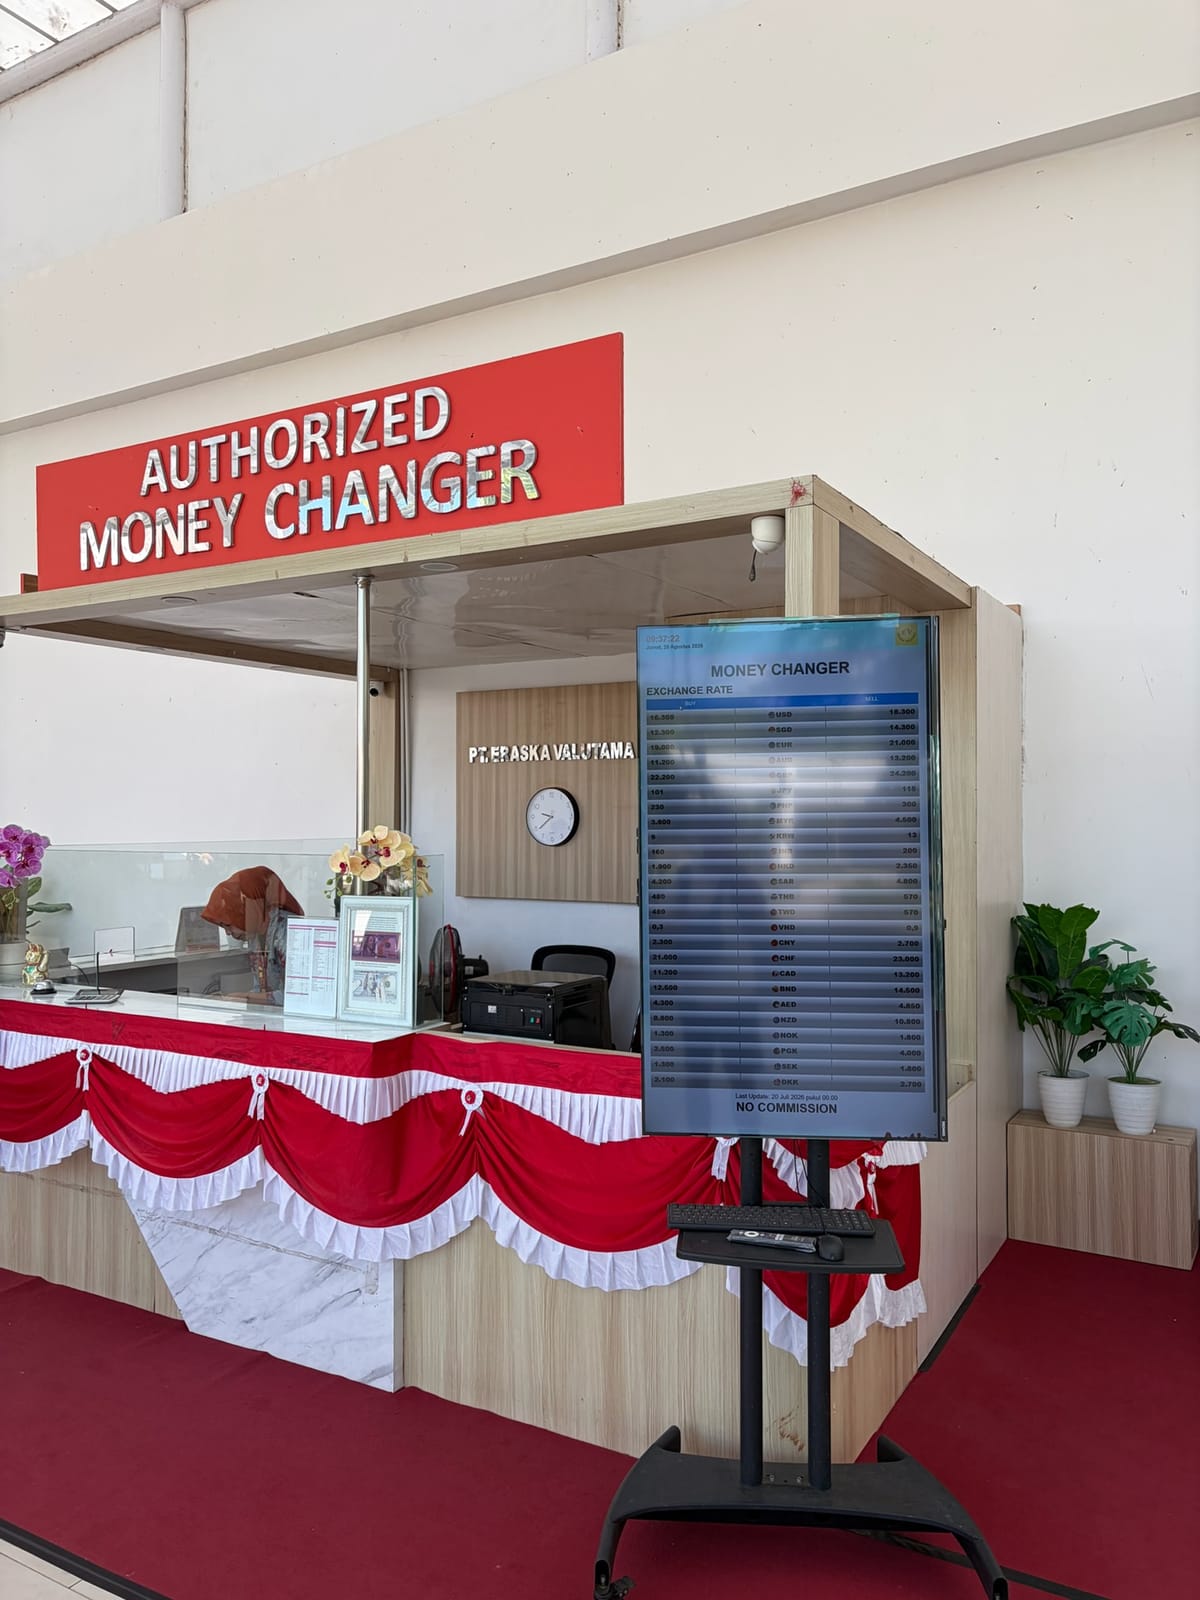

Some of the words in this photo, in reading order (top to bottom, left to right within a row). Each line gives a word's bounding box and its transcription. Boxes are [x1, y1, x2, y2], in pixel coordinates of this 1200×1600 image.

[139, 385, 451, 497] AUTHORIZED
[79, 492, 244, 571] MONEY
[264, 439, 540, 541] CHANGER
[711, 664, 766, 678] MONEY
[771, 661, 850, 675] CHANGER
[646, 686, 703, 696] EXCHANGE
[706, 685, 733, 695] RATE
[490, 744, 551, 762] ERASKA
[553, 741, 636, 761] VALUTAMA
[736, 1102, 754, 1112] NO
[758, 1102, 838, 1114] COMMISSION
